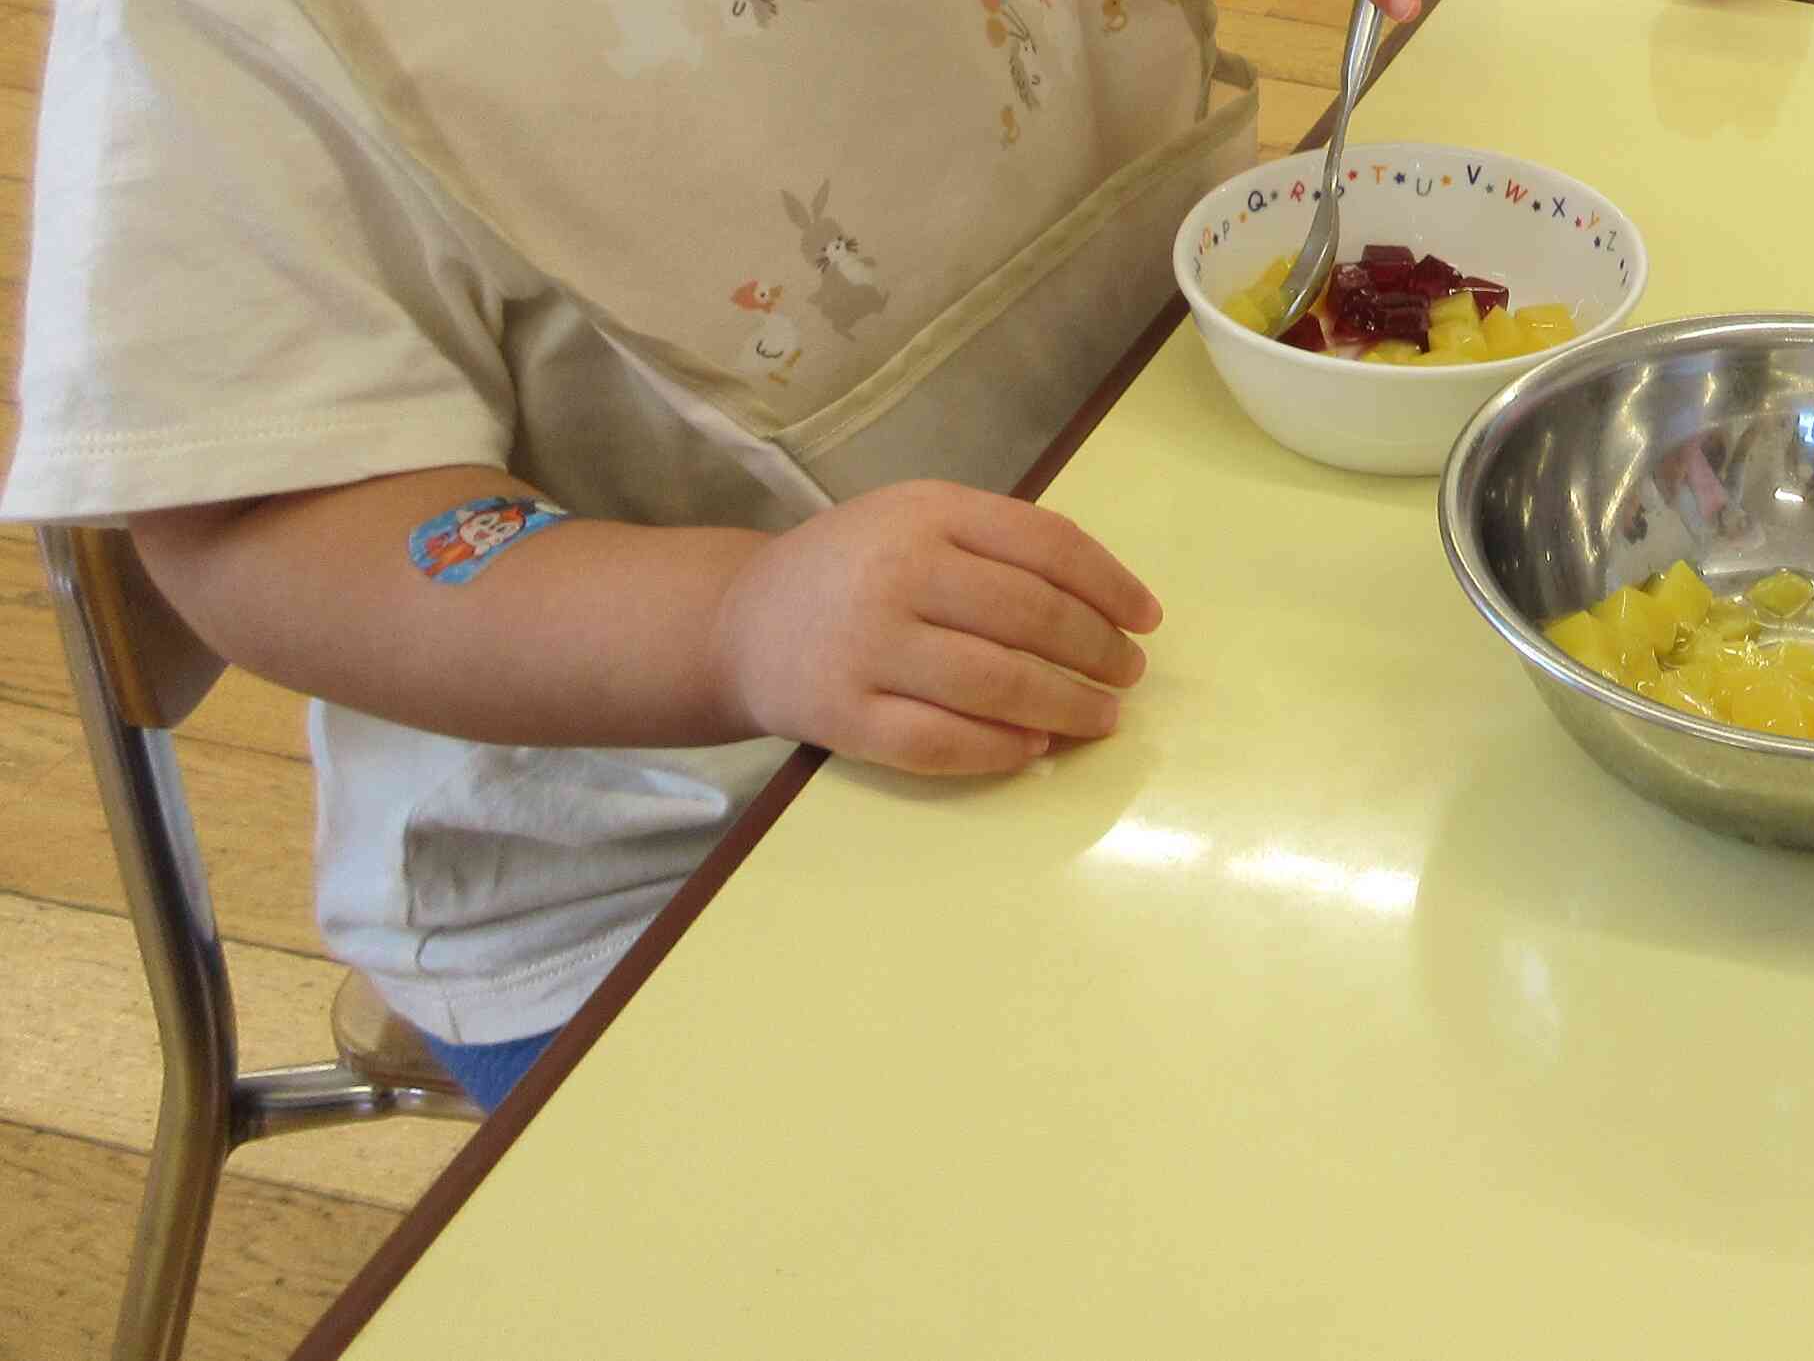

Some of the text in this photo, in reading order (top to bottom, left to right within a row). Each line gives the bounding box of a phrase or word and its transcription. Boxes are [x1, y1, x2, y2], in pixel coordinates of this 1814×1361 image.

[1221, 219, 1230, 240] P
[1248, 190, 1267, 212] Q
[1290, 180, 1306, 203] R
[1372, 165, 1388, 184] T
[1416, 179, 1432, 197] U
[1467, 164, 1482, 185] V
[1505, 179, 1529, 204] W
[1552, 197, 1567, 218] X
[1606, 231, 1617, 252] Z
